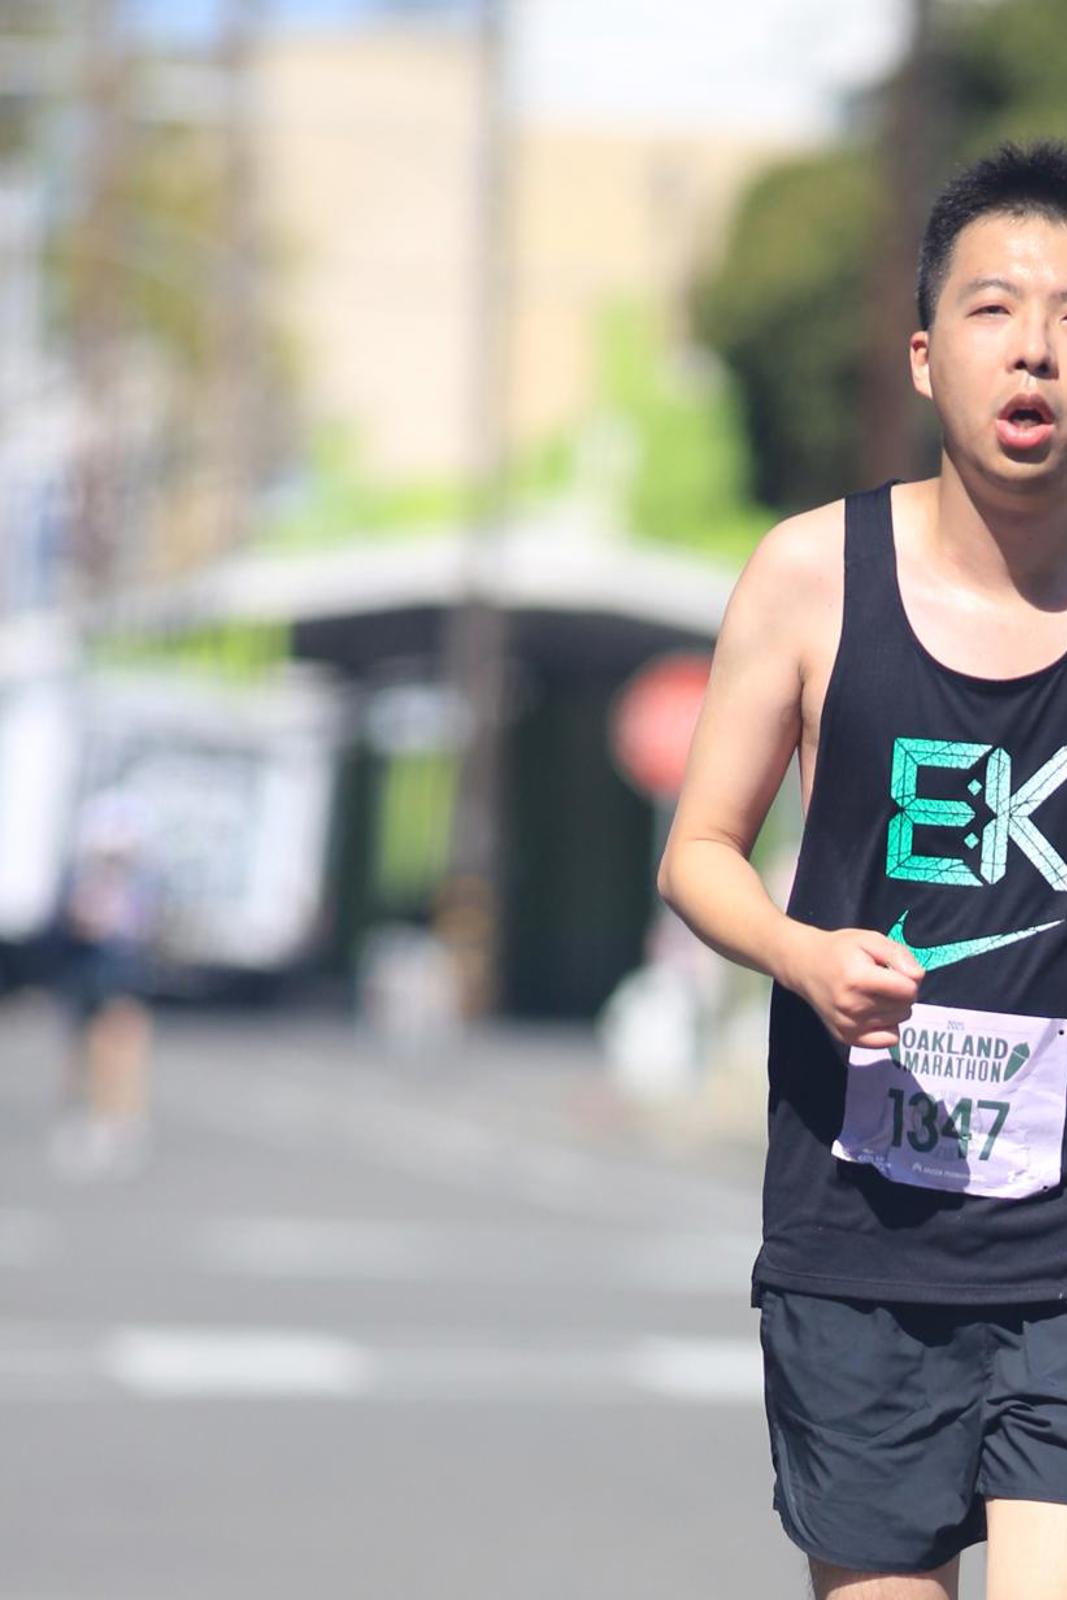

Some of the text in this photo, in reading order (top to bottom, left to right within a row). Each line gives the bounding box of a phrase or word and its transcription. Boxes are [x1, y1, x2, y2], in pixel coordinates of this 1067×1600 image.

[901, 1027, 1009, 1060] OAKLAND
[902, 1052, 1002, 1083] MARATHON
[887, 1088, 1011, 1161] 1347
